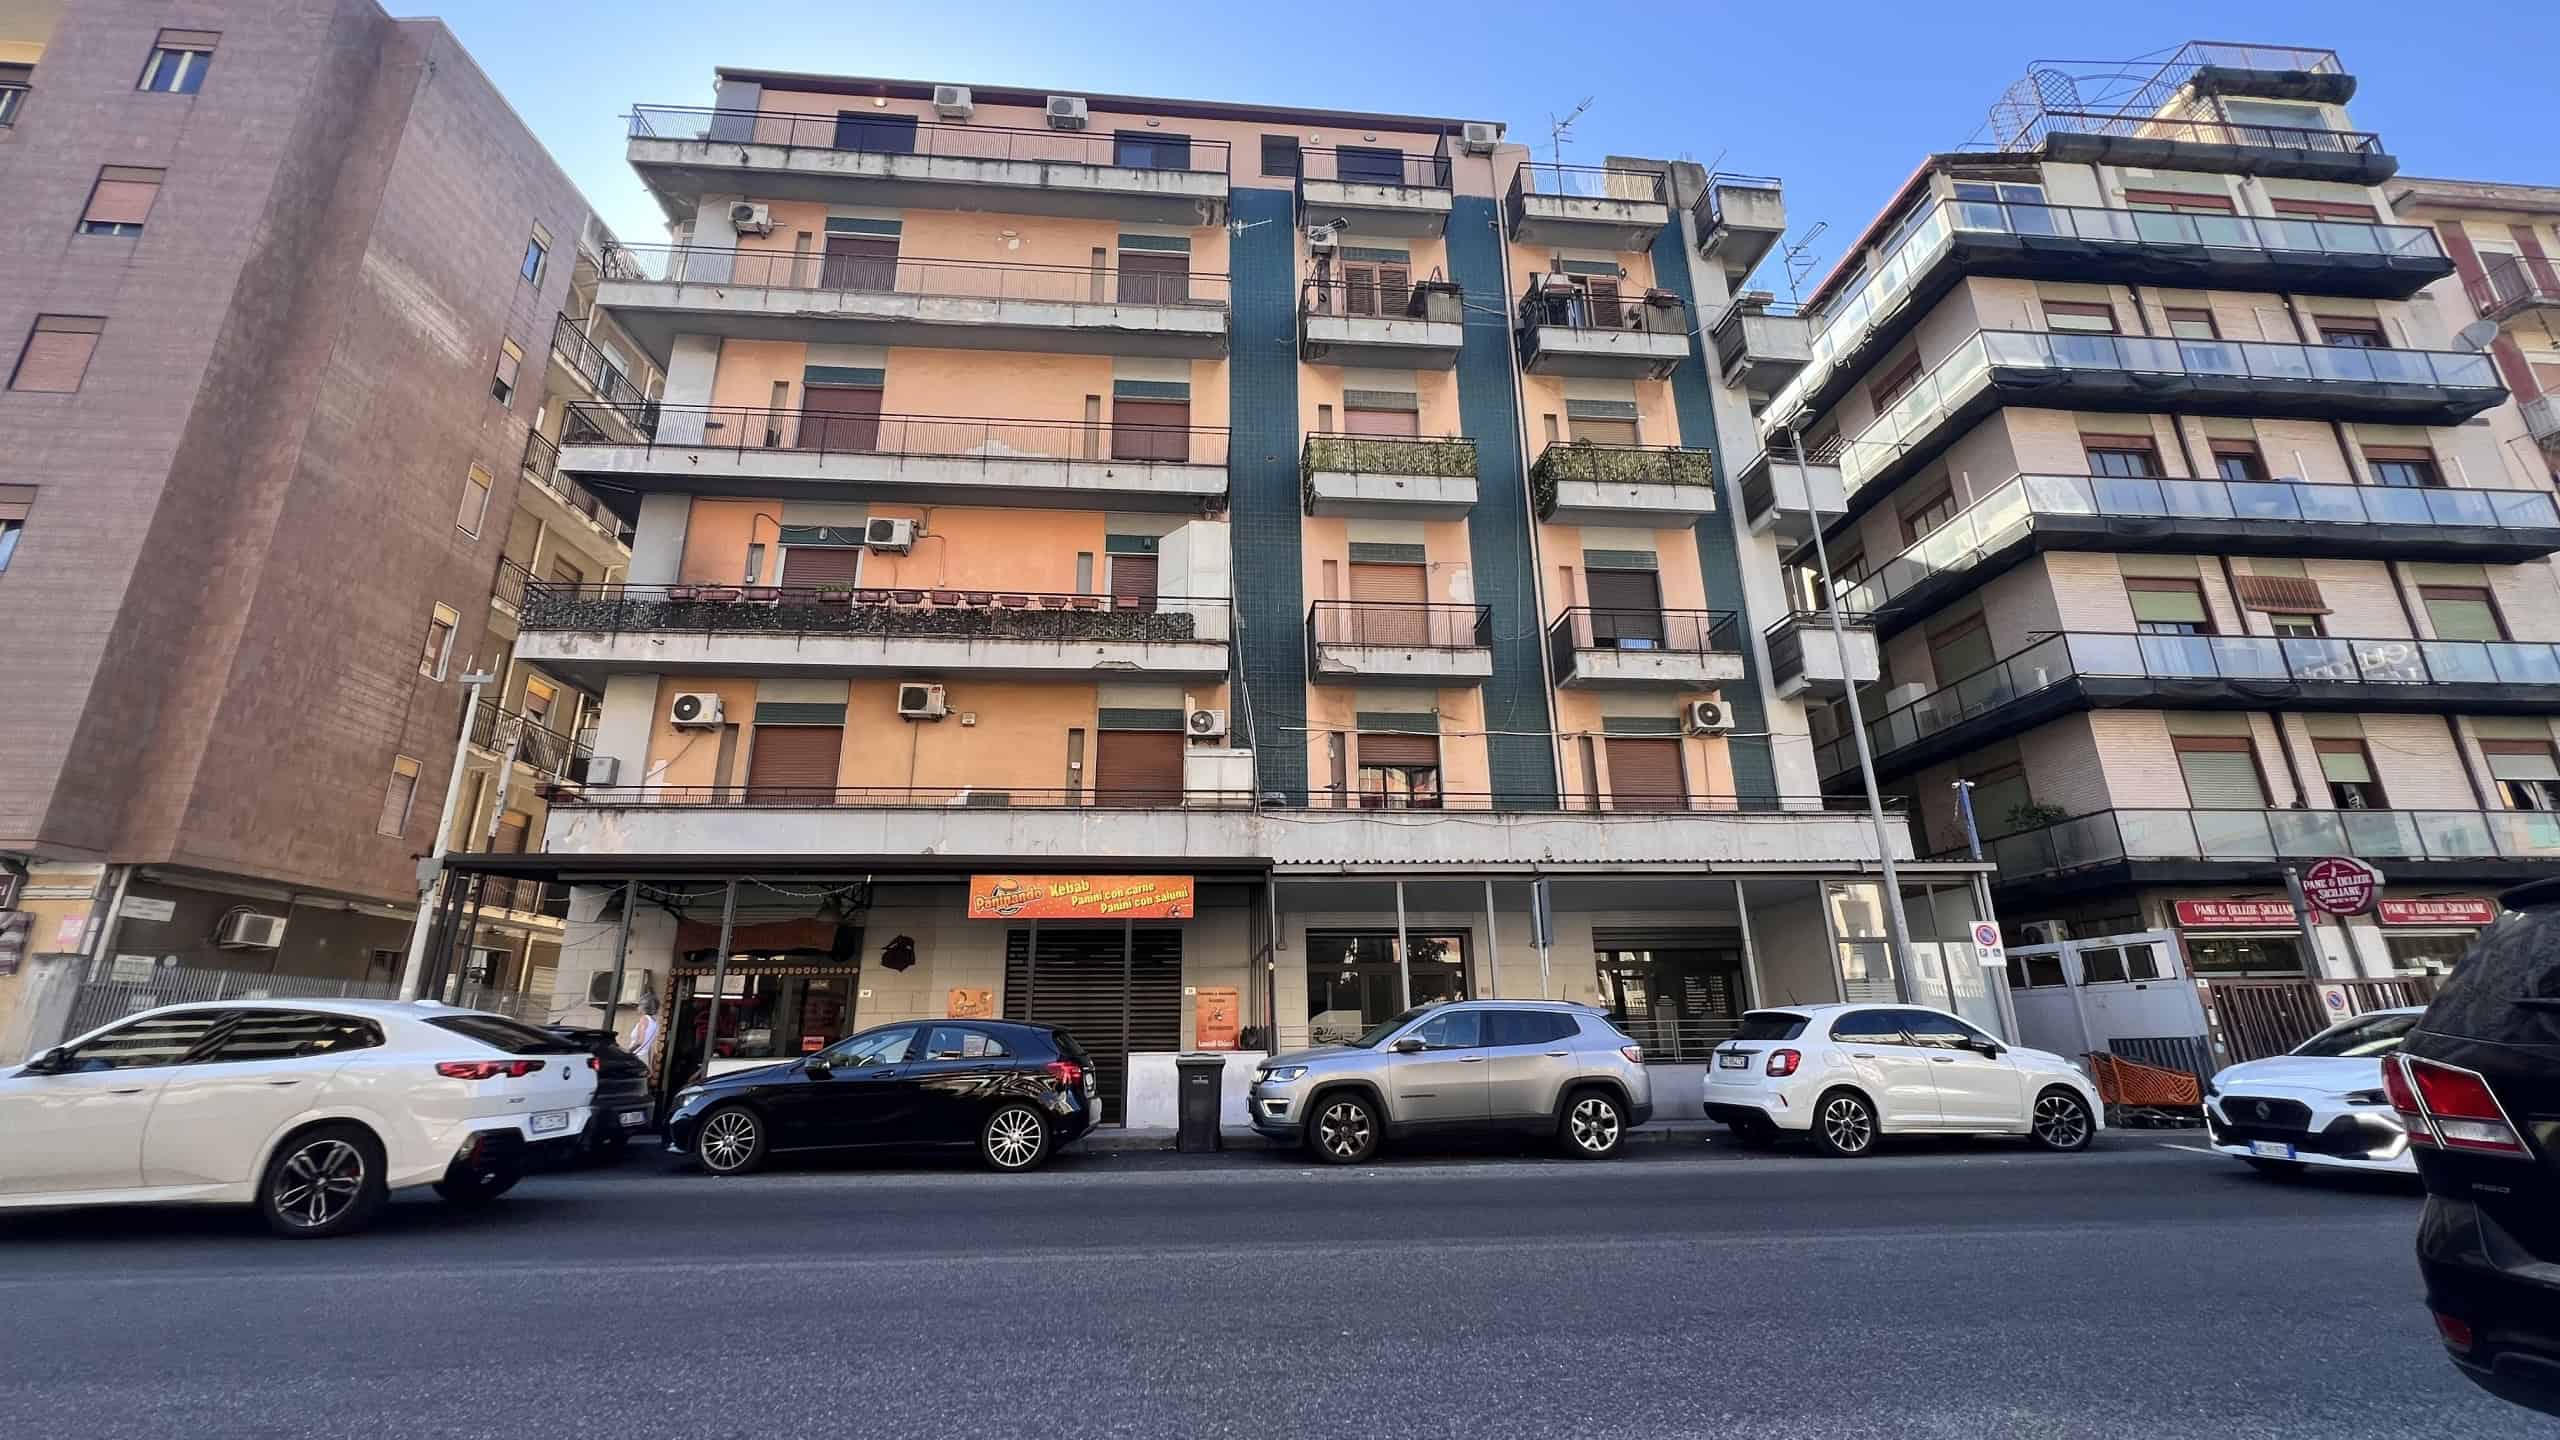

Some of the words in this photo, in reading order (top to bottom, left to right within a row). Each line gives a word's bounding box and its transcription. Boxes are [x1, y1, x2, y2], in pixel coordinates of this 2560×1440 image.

[1048, 879, 1090, 897] Kebab
[2303, 879, 2327, 891] PANE
[2336, 873, 2371, 887] DELIZIE
[1071, 891, 1103, 907] Panini
[1104, 889, 1125, 901] con
[1127, 882, 1156, 895] carne
[1101, 900, 1133, 914] Panini
[1134, 895, 1155, 907] con
[1155, 885, 1190, 903] salumi
[2319, 886, 2361, 899] SICILIANE
[2193, 903, 2218, 917] PANE
[2226, 903, 2258, 915] DELIZIE
[2383, 903, 2407, 914] PANE
[2415, 902, 2446, 914] DELIZIE
[2446, 902, 2486, 914] SICILIANE
